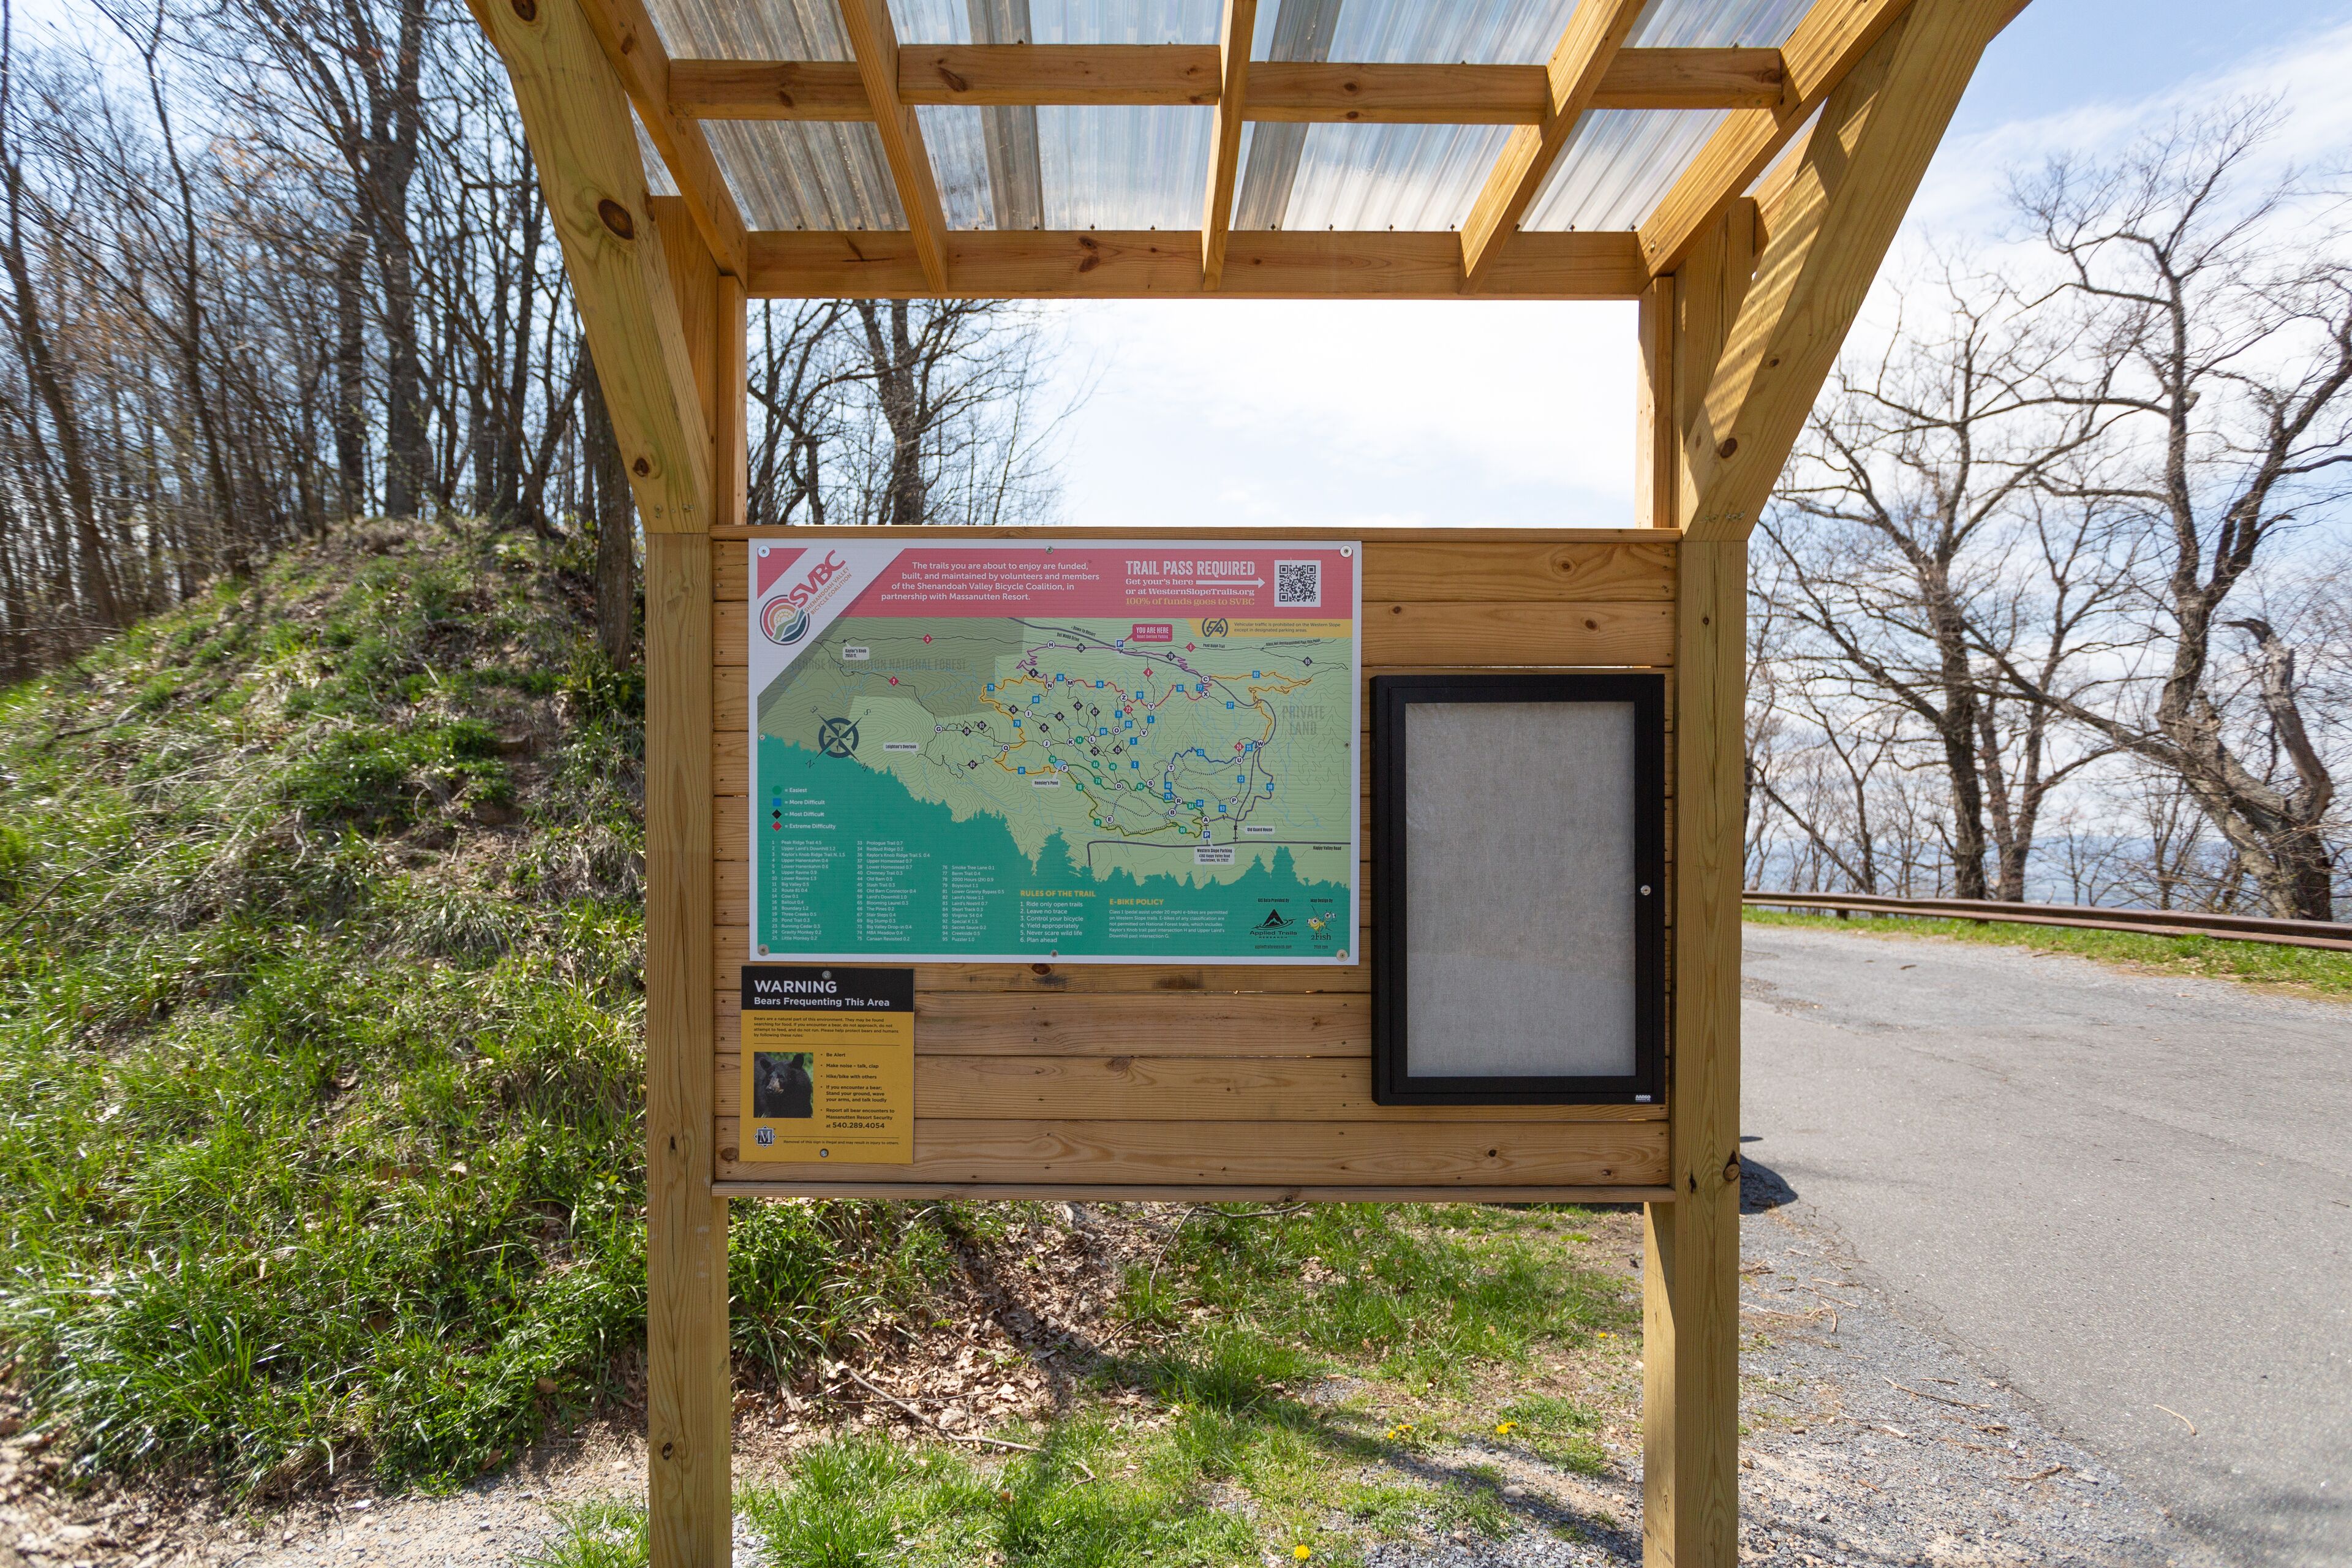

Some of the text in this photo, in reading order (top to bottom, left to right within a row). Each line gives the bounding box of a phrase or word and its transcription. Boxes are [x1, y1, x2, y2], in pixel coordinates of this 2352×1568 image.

[1019, 562, 1041, 571] enjoy
[1126, 561, 1254, 578] TRAIL PASS REQUIRED
[789, 549, 846, 608] SVBC
[989, 573, 998, 581] by
[804, 567, 850, 612] SHENANDOAH VALLEY
[969, 582, 993, 592] Valley
[810, 573, 852, 615] BICYCLE COALITION
[881, 593, 927, 601] partnership
[1289, 721, 1317, 735] LAND
[755, 980, 837, 993] WARNING
[784, 998, 842, 1007] Frequenting
[760, 1131, 771, 1143] M
